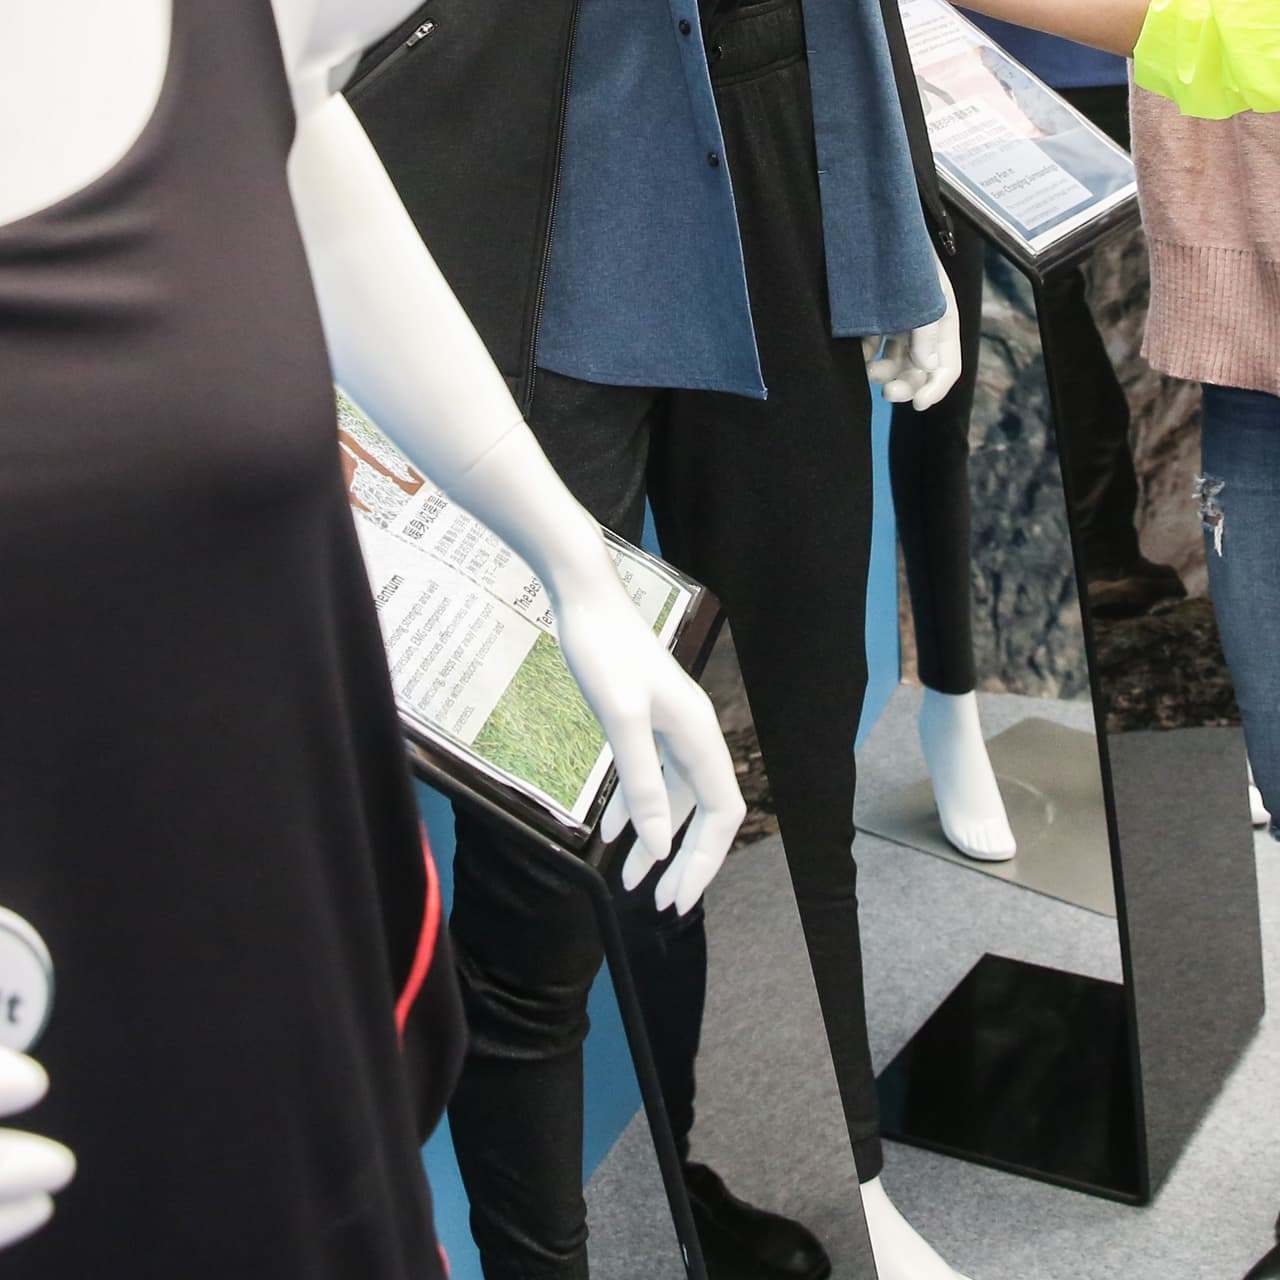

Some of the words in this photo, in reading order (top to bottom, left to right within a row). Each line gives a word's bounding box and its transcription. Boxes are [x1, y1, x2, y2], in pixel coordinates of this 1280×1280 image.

[402, 491, 449, 540] 暖身收操最
[374, 574, 406, 612] mentum
[513, 594, 533, 611] The
[536, 609, 553, 628] Tem
